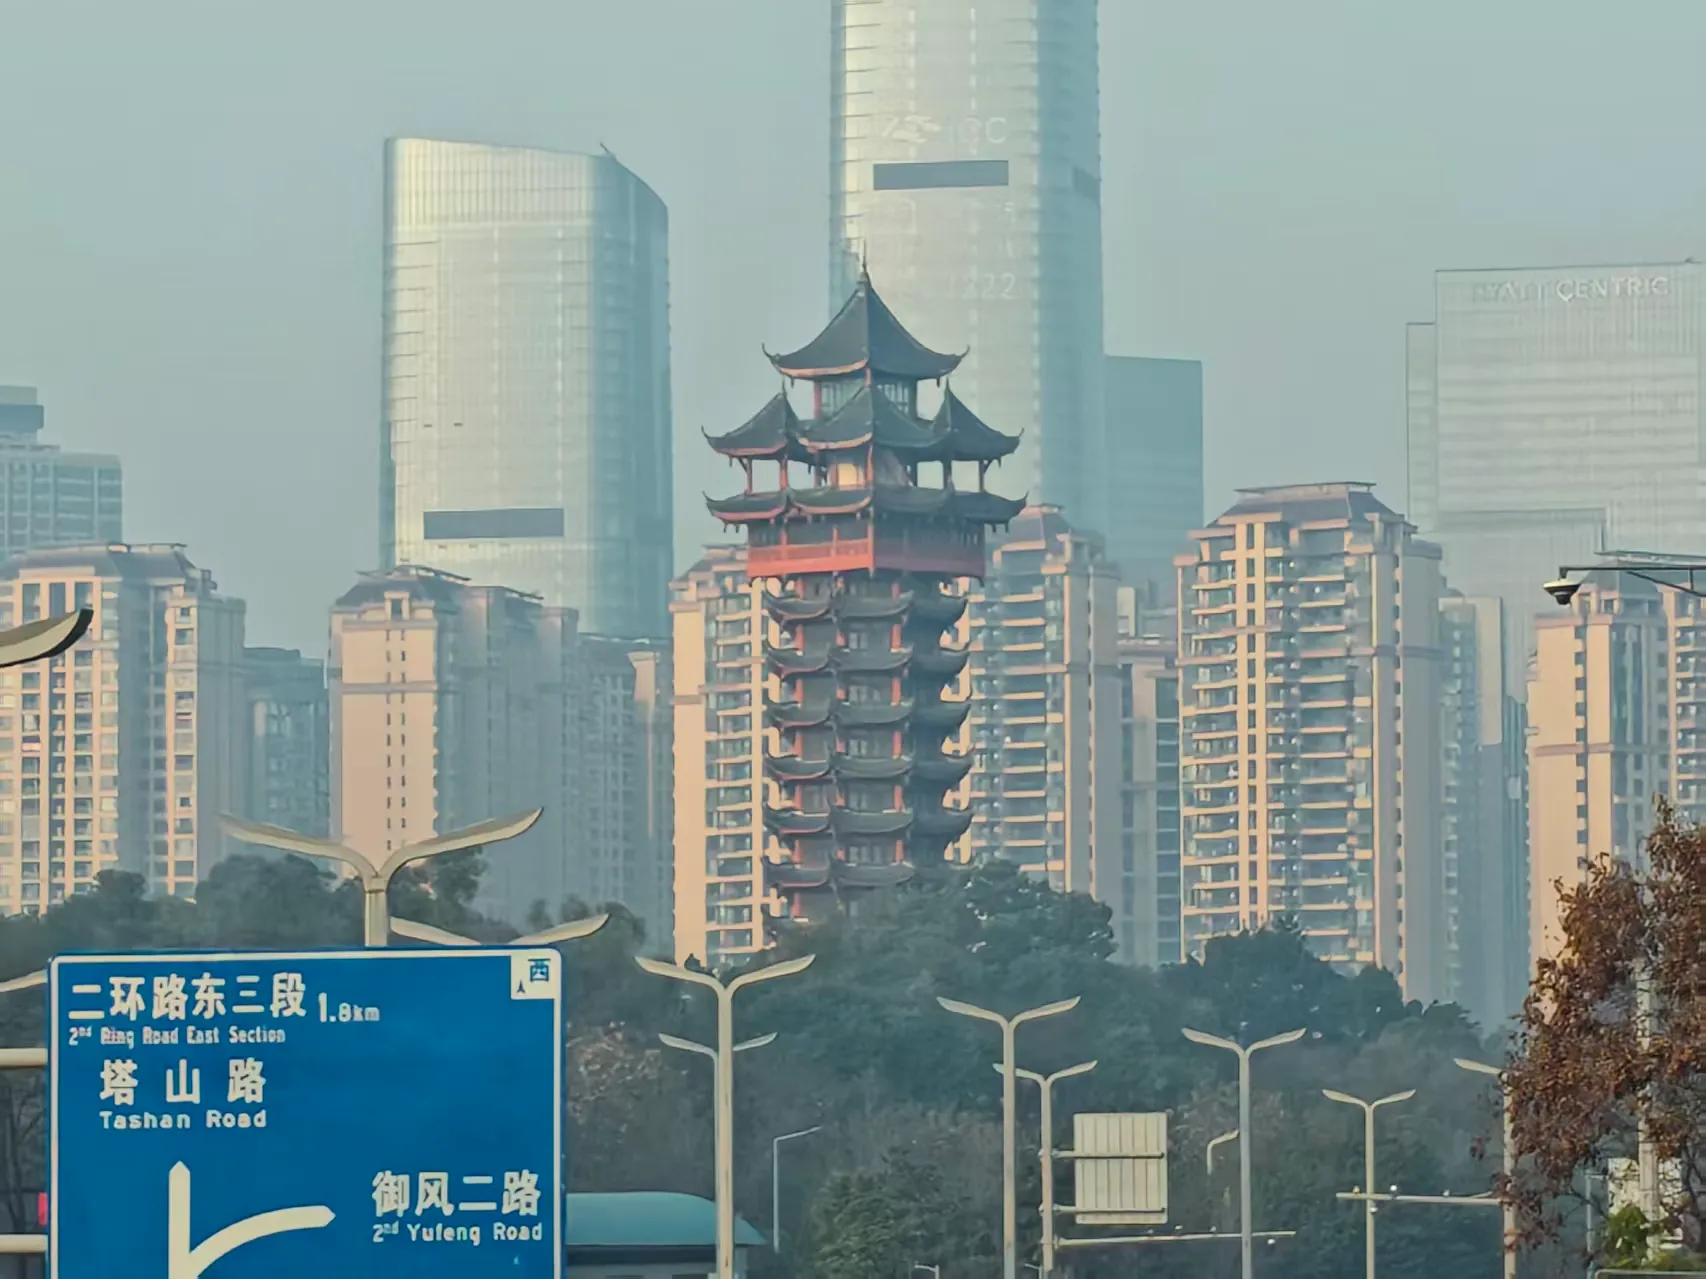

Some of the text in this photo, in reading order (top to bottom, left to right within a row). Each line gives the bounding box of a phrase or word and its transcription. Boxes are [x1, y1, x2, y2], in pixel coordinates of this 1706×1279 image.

[1556, 276, 1670, 302] CENTRIC
[68, 972, 307, 1021] 二环路东三段
[318, 992, 381, 1023] 1.8km
[68, 1024, 286, 1049] 2nd Ring Road East Section
[99, 1057, 266, 1105] 塔山路
[99, 1109, 267, 1129] Tashan Road
[372, 1169, 541, 1217] 御风二路
[372, 1220, 543, 1246] 2nd Yufeng Road
